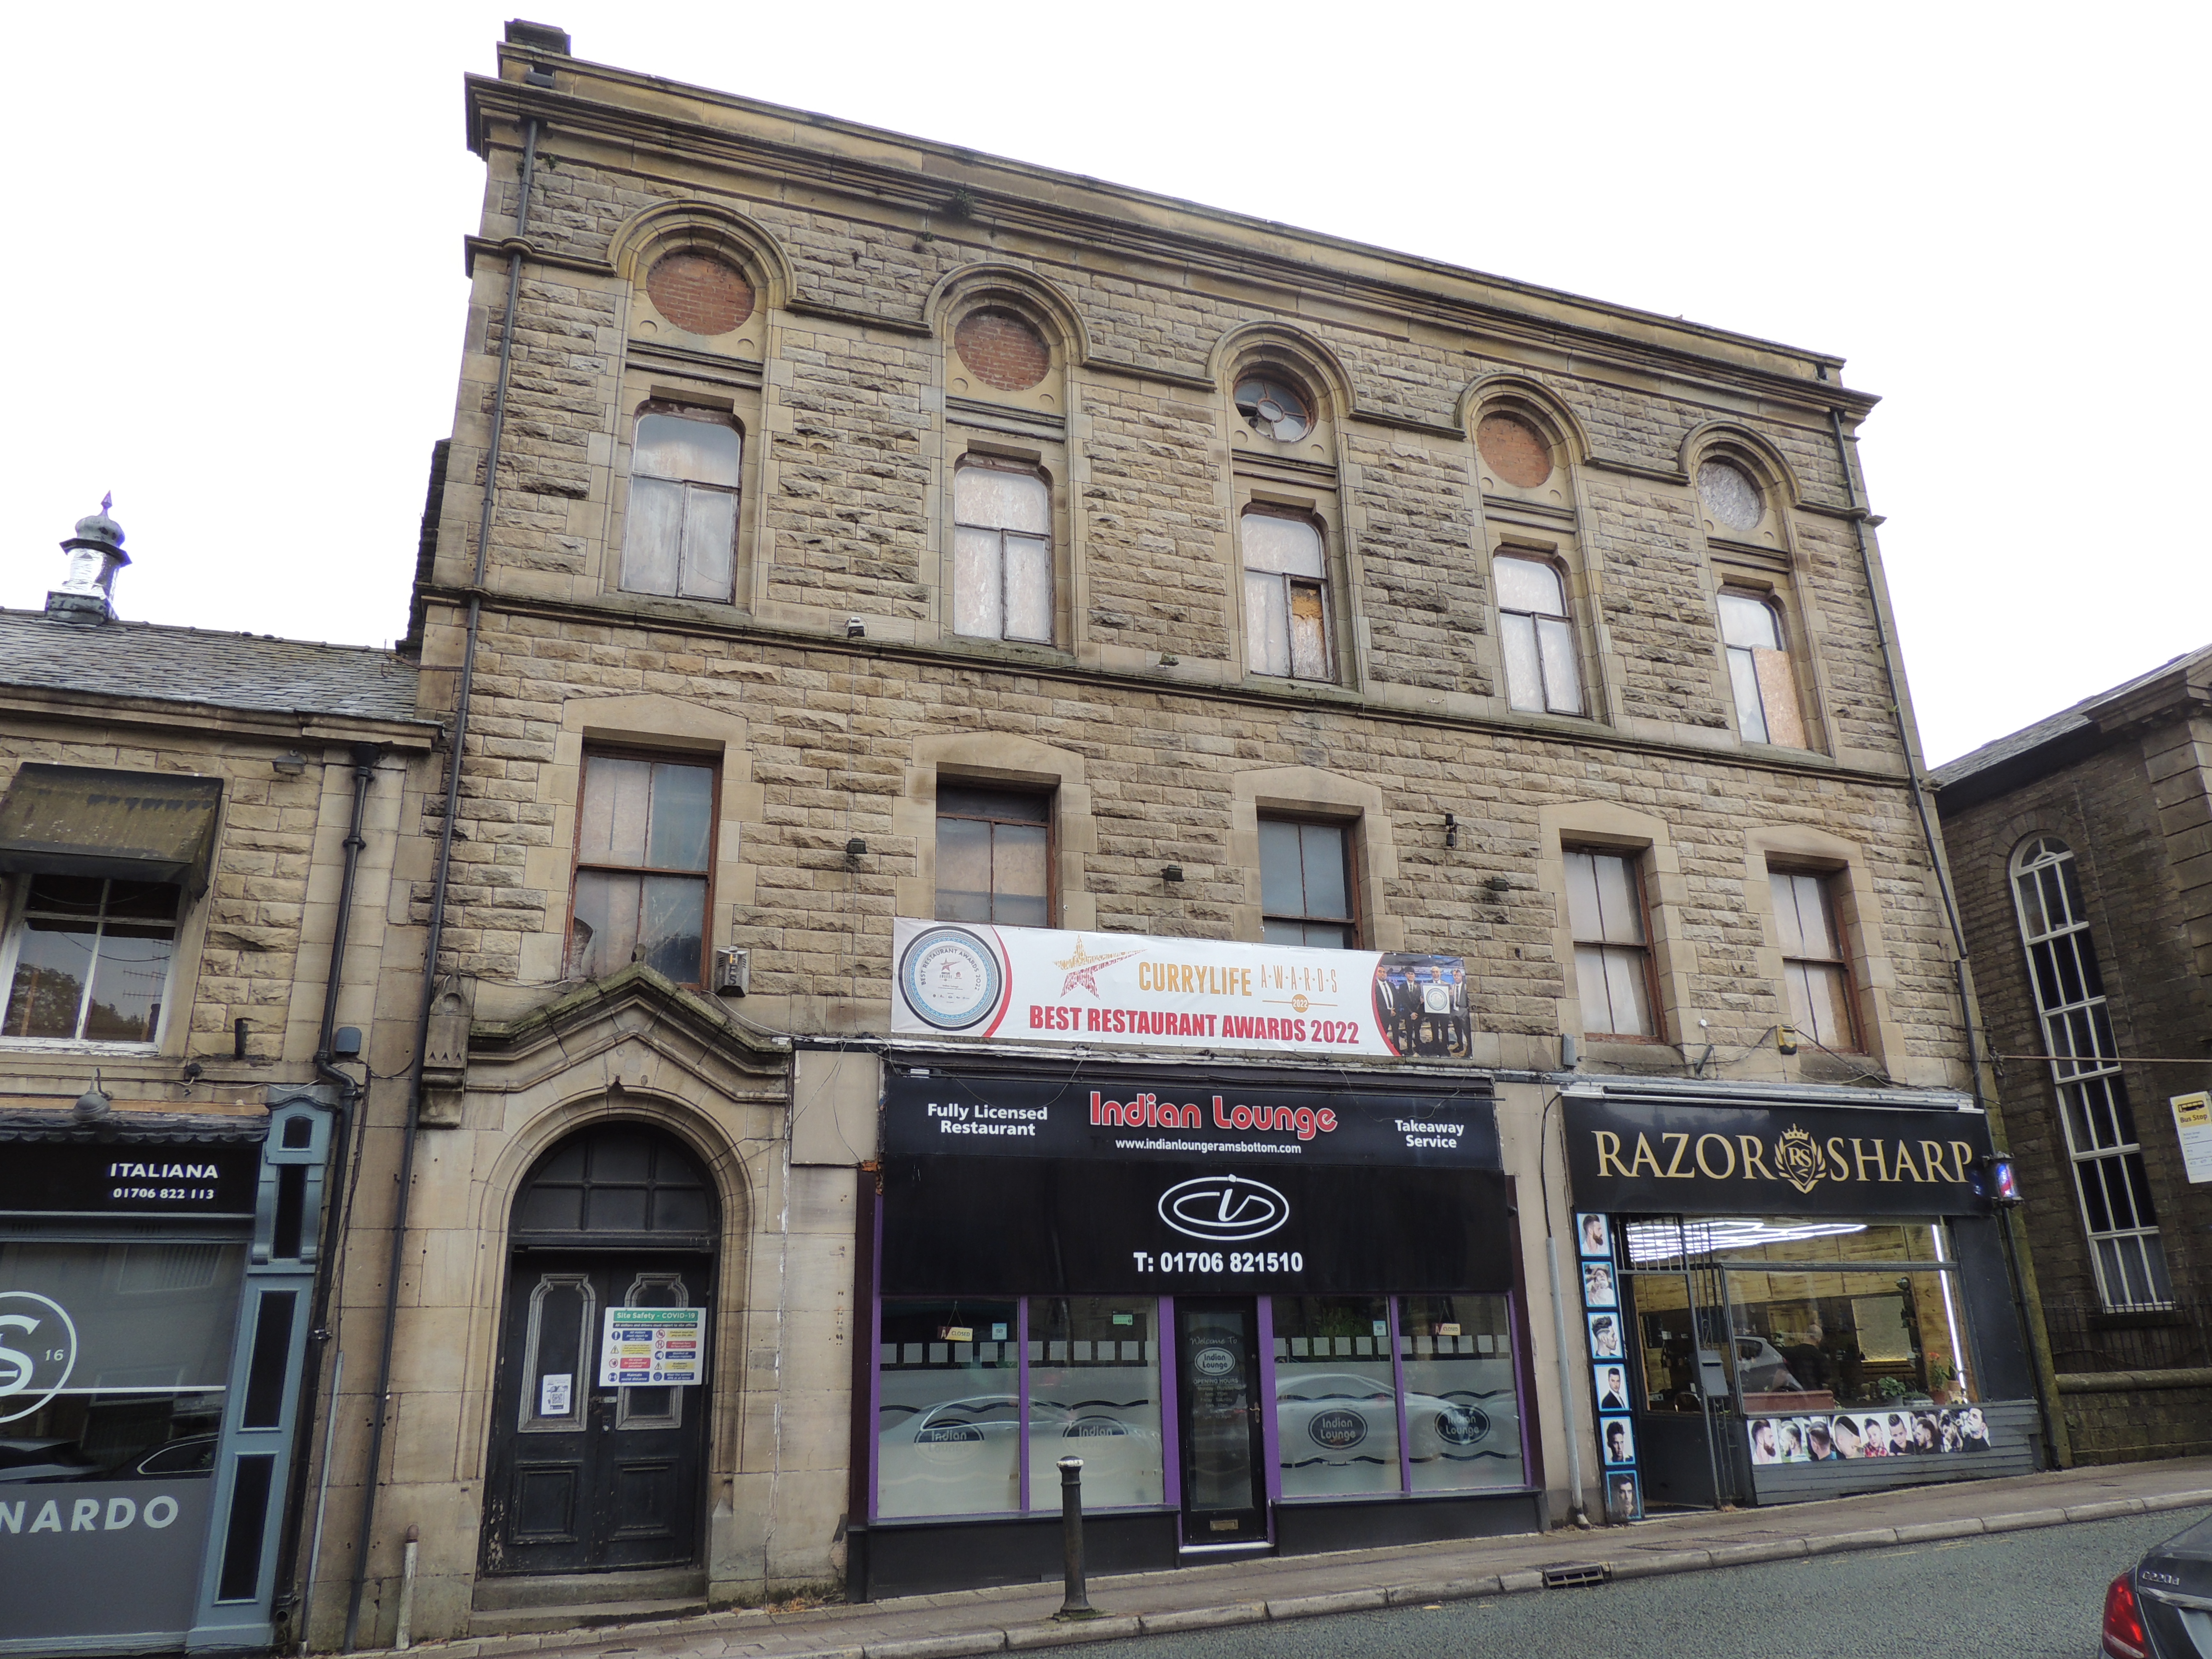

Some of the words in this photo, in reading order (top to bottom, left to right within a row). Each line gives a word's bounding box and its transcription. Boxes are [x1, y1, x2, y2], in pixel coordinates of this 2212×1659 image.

[923, 948, 958, 968] RESTAURANT
[959, 951, 979, 972] AWARDS
[1139, 962, 1251, 997] CURRYLIFE
[1293, 999, 1308, 1009] 2022
[1030, 1005, 1082, 1031] BEST
[1088, 1009, 1217, 1038] RESTAURANT
[1222, 1015, 1306, 1042] AWARDS
[1310, 1020, 1359, 1044] 2022
[927, 1103, 969, 1120] Fully
[974, 1105, 1048, 1120] Licensed
[1090, 1091, 1202, 1129] Indian
[1212, 1095, 1338, 1141] Lounge
[941, 1120, 1035, 1136] Restaurant
[1395, 1119, 1465, 1136] Takeaway
[1115, 1138, 1301, 1155] www.indianloungeramsbottom.com
[1406, 1134, 1457, 1149] Service
[1591, 1130, 1778, 1180] RAZOR
[1825, 1137, 1972, 1183] SHARP
[1789, 1147, 1812, 1167] RS
[110, 1163, 218, 1178] ITALIANA
[113, 1188, 156, 1199] 01706
[160, 1189, 185, 1199] 822
[191, 1189, 214, 1200] 113
[1133, 1252, 1154, 1272] T:
[1160, 1252, 1224, 1273] 01706
[1230, 1252, 1303, 1273] 821510
[1190, 1336, 1225, 1345] Welcome
[45, 1349, 64, 1361] 16
[1202, 1361, 1227, 1370] Lounge
[1322, 1418, 1353, 1428] Indian
[1445, 1425, 1479, 1436] Lounge
[931, 1431, 967, 1441] Indian
[1079, 1426, 1113, 1437] Indian
[1320, 1429, 1356, 1442] Lounge
[0, 1495, 179, 1534] NARDO
